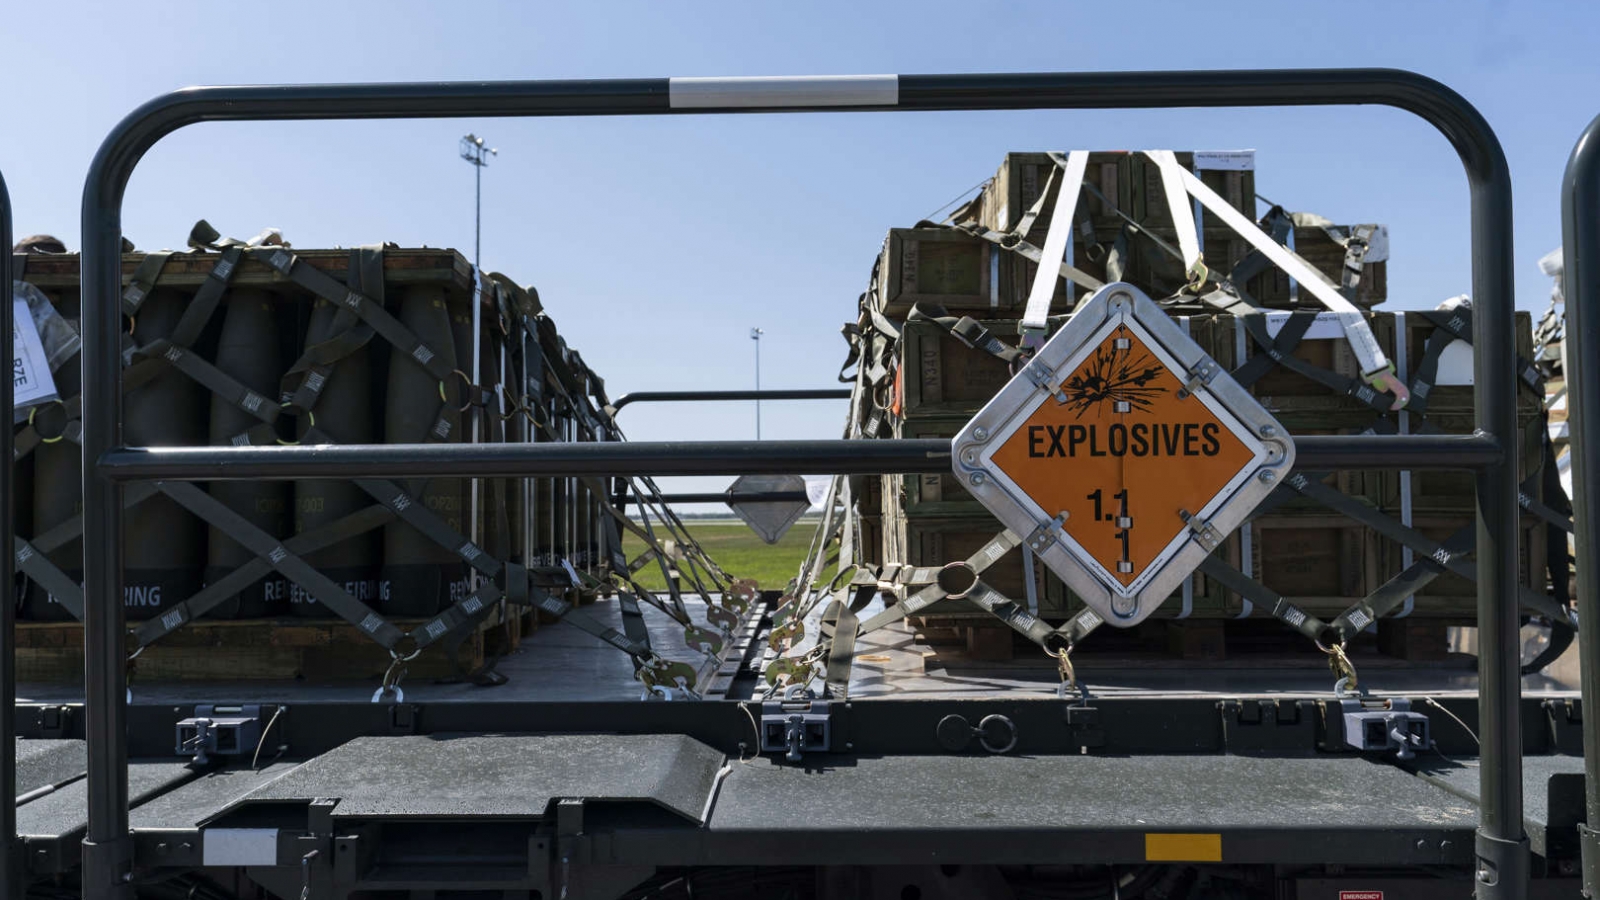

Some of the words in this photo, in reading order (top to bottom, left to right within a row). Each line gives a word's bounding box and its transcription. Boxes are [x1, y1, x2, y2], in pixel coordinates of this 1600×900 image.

[924, 350, 937, 387] N340
[1028, 422, 1220, 458] EXPLOSIVES
[1087, 489, 1128, 522] 1.1
